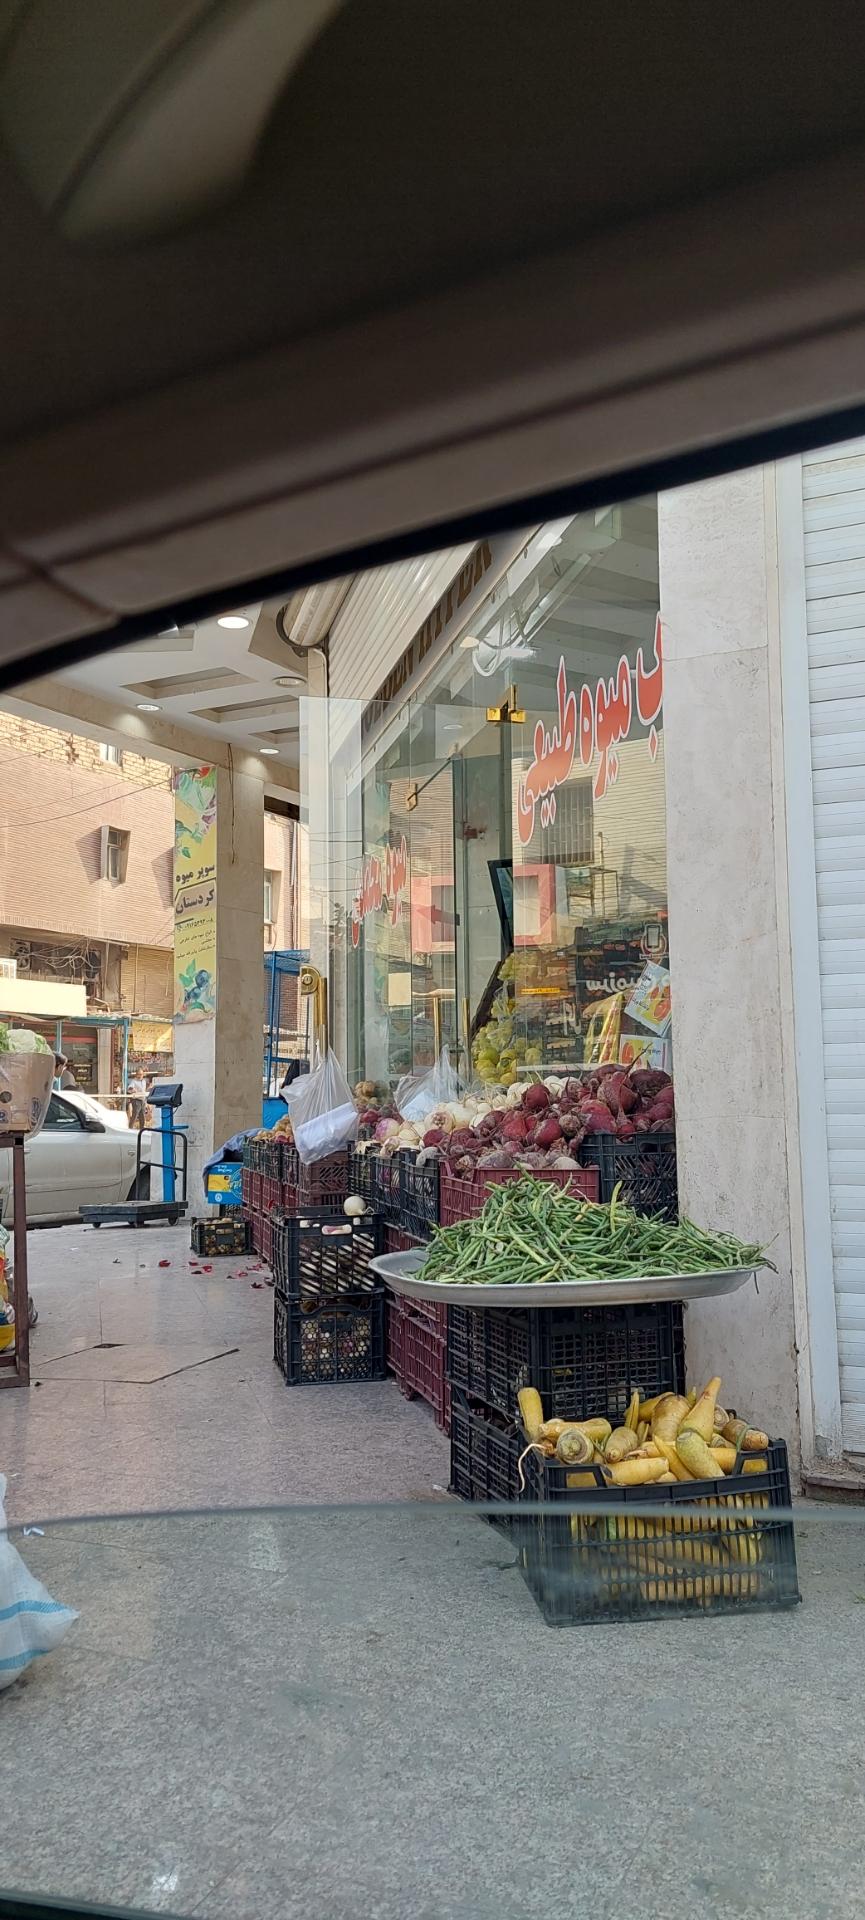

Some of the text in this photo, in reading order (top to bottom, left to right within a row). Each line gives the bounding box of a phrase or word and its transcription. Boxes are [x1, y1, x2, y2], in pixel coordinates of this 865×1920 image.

[517, 655, 577, 847] طبیعی
[580, 654, 632, 801] میوه
[175, 864, 215, 885] سوپر میوه
[175, 888, 215, 915] کردستان
